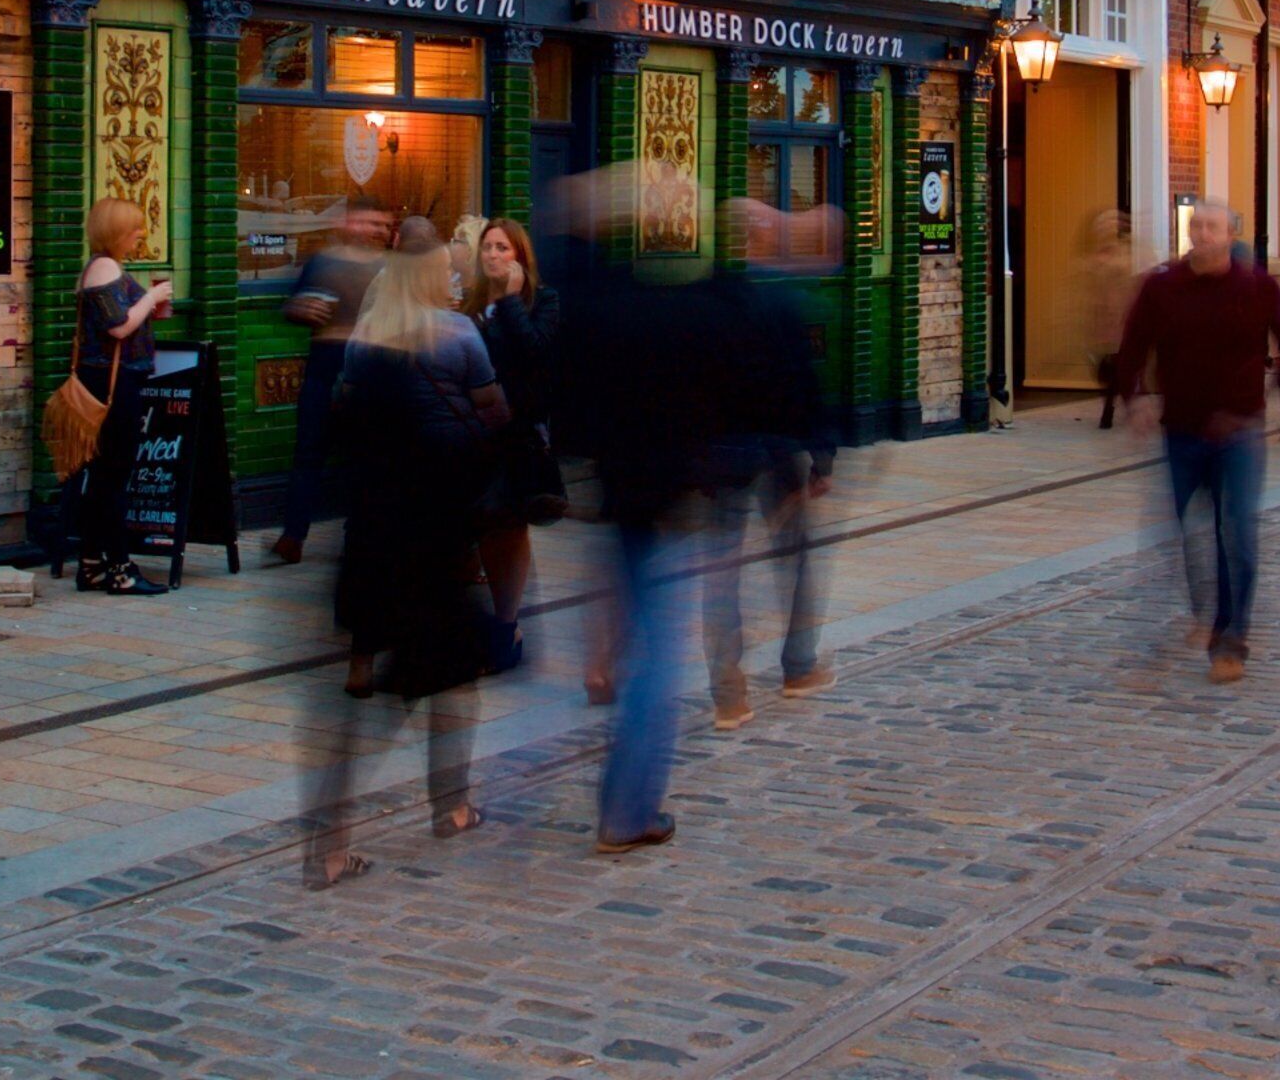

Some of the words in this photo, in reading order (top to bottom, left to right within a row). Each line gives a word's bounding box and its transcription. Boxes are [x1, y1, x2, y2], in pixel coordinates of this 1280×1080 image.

[643, 3, 743, 42] HUMBER
[754, 17, 816, 49] DOCK
[824, 26, 904, 59] tavern
[167, 400, 190, 415] LIVE
[138, 510, 177, 524] CARLING
